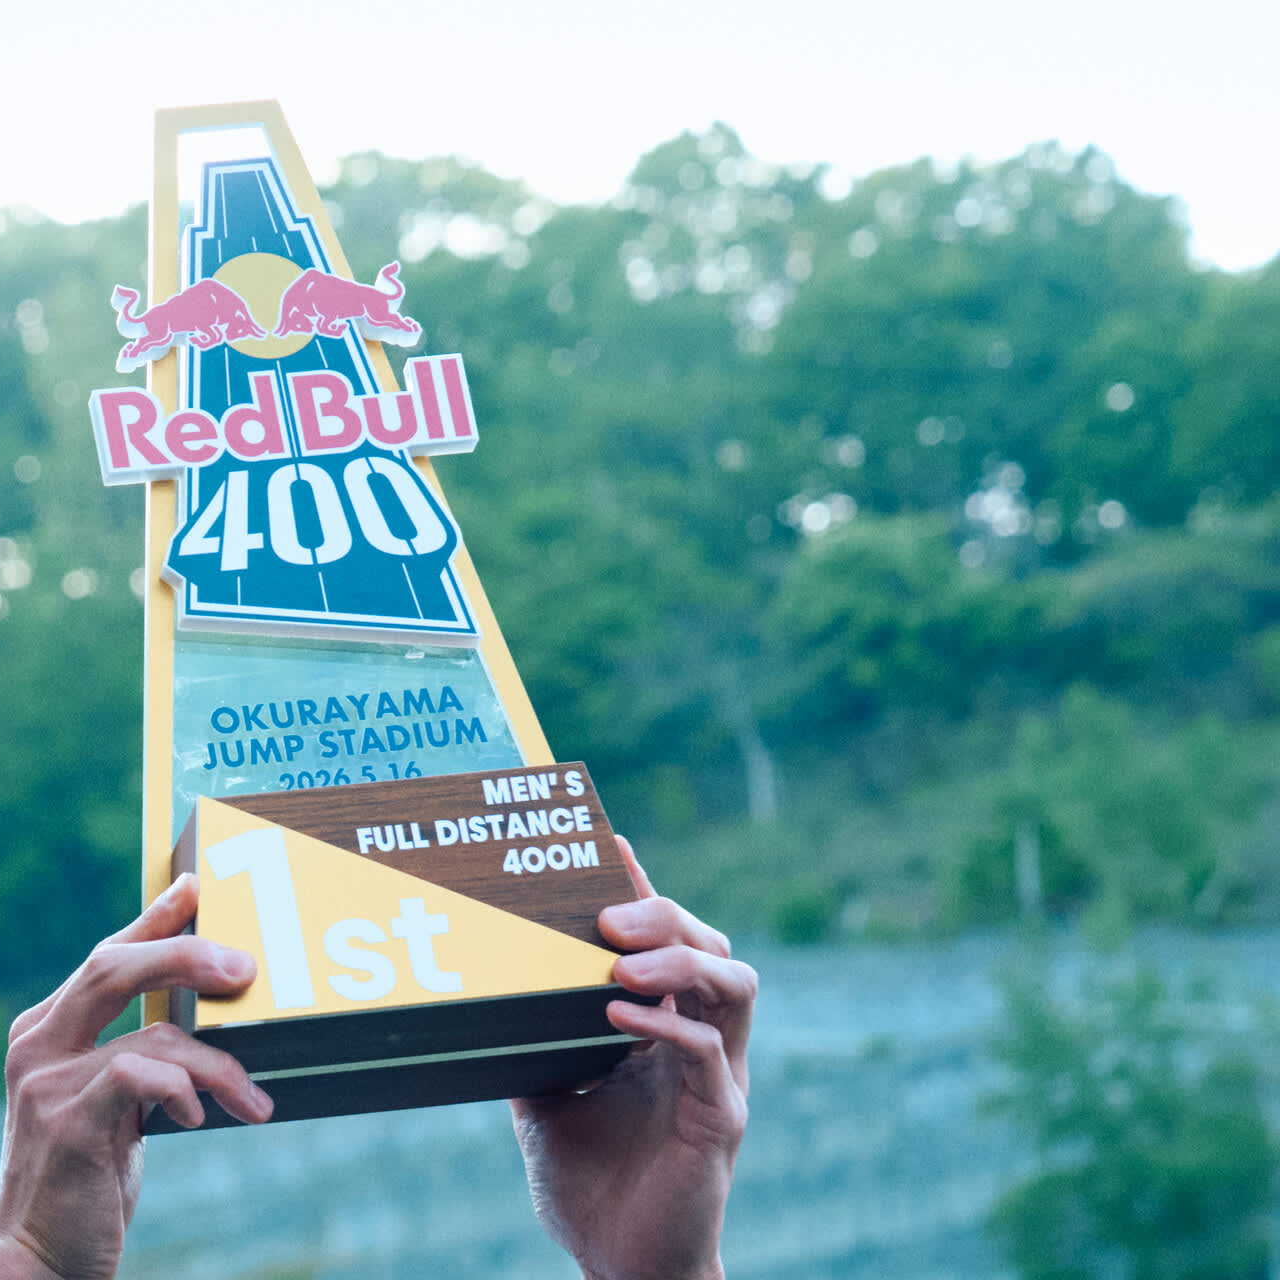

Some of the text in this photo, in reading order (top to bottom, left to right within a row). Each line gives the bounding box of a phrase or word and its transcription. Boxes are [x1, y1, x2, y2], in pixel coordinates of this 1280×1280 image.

[98, 357, 473, 470] Red Bull
[178, 456, 449, 572] 400
[210, 685, 464, 735] OKURAYAMA
[203, 716, 489, 771] JUMP STADIUM
[356, 805, 593, 854] FULL DISTANCE
[502, 840, 600, 875] 400M
[203, 825, 464, 1010] 1st
